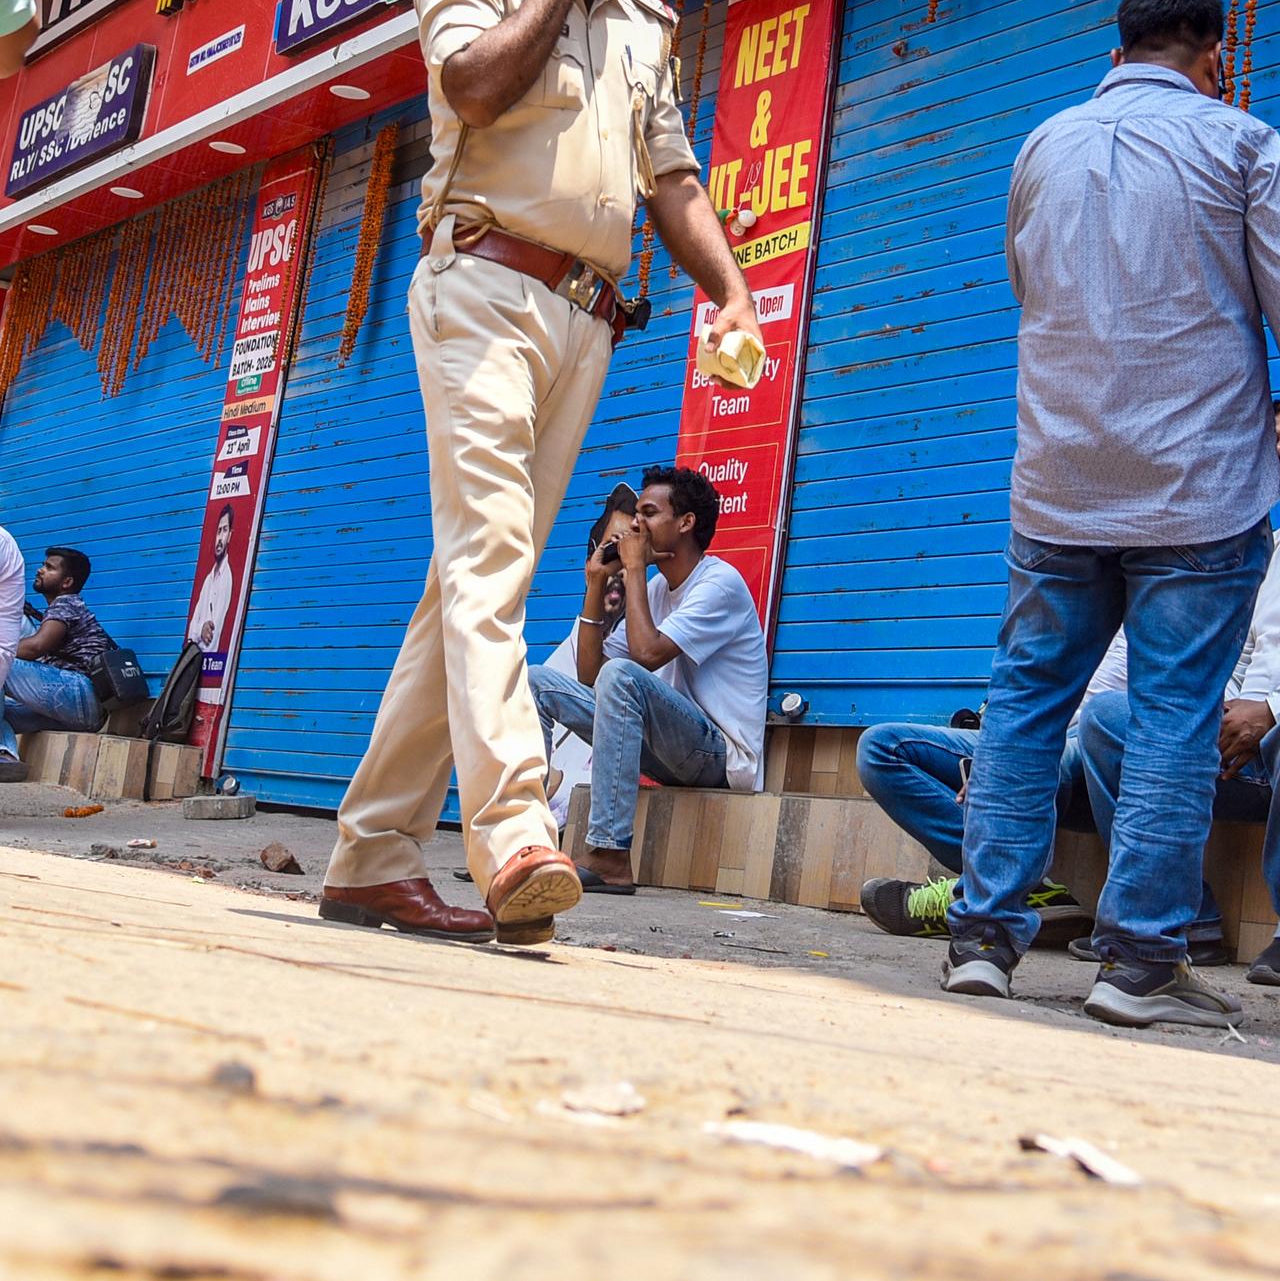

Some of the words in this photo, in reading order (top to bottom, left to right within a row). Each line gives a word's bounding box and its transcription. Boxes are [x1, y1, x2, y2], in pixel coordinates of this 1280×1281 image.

[734, 4, 811, 89] NEET
[20, 94, 66, 150] UPSC
[749, 90, 772, 148] &
[247, 219, 297, 273] UPSC
[754, 230, 798, 261] BATCH
[760, 295, 784, 316] Open
[235, 333, 277, 356] FOUNDATION
[692, 368, 716, 389] Bes
[224, 403, 239, 420] Hindi
[240, 400, 266, 416] Medium
[711, 396, 750, 417] Team
[698, 459, 748, 482] Quality
